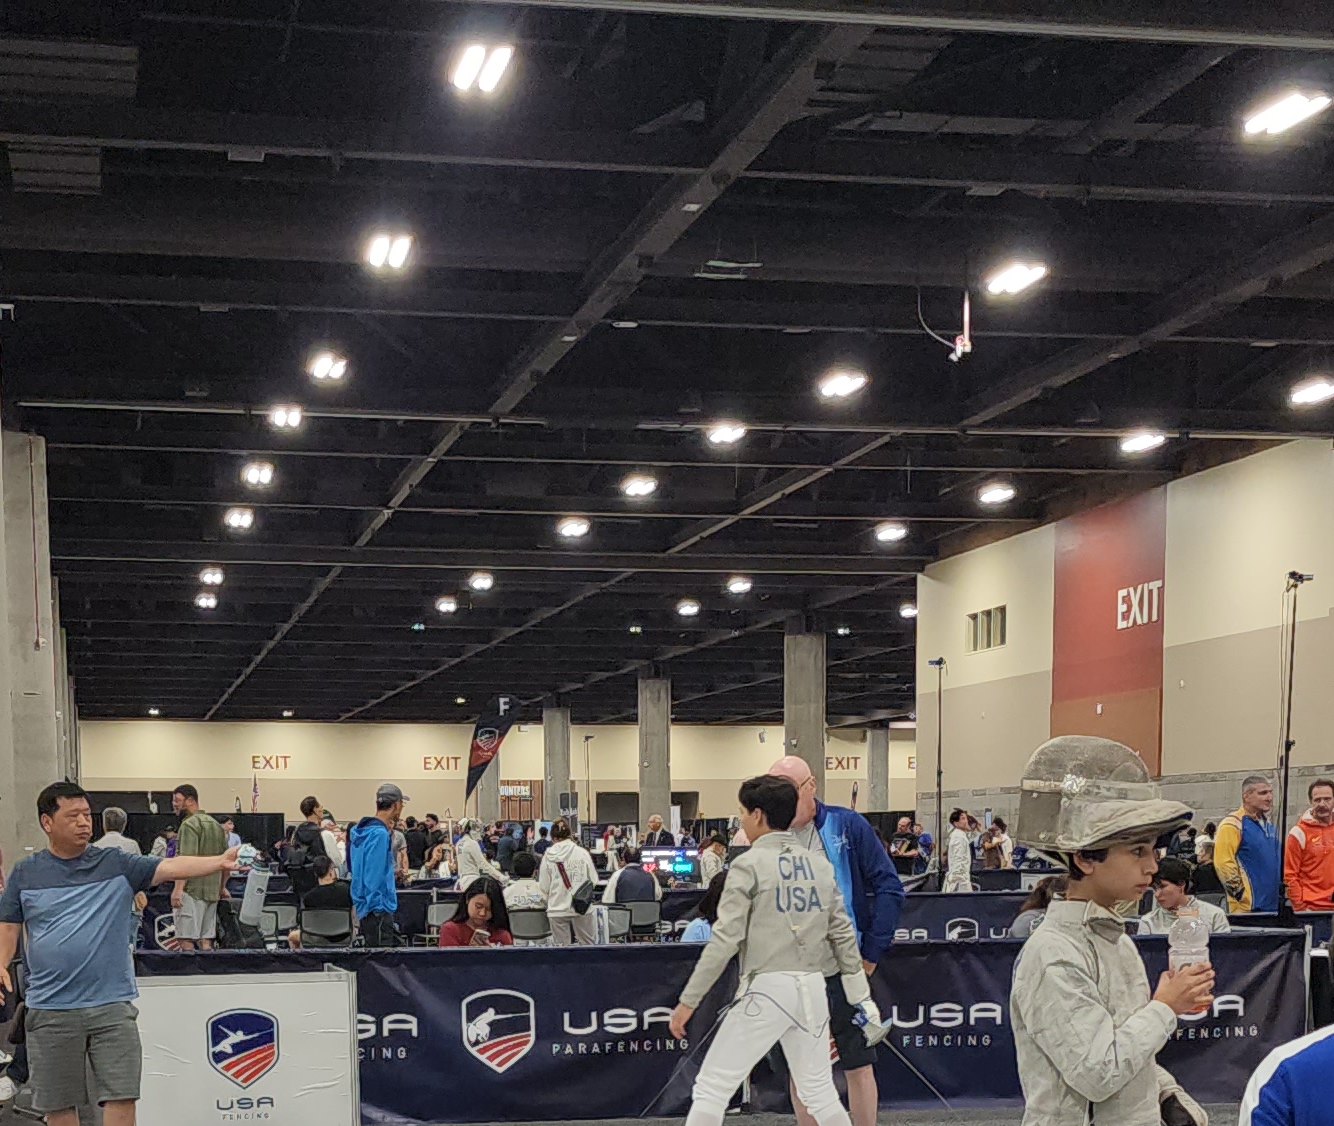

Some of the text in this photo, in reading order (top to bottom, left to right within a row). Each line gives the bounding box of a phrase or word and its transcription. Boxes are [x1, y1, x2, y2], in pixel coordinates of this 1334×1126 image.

[1117, 579, 1163, 630] EXIT
[498, 697, 511, 716] F
[252, 755, 291, 770] EXIT
[423, 756, 461, 771] EXIT
[825, 756, 861, 771] EXIT
[778, 855, 815, 881] CHI
[775, 885, 824, 913] USA
[563, 1006, 675, 1035] USA
[891, 1002, 1002, 1029] USA
[552, 1039, 689, 1056] PARAFENCING
[902, 1034, 992, 1048] FENCING
[216, 1096, 274, 1111] USA
[221, 1111, 270, 1121] FENCING
